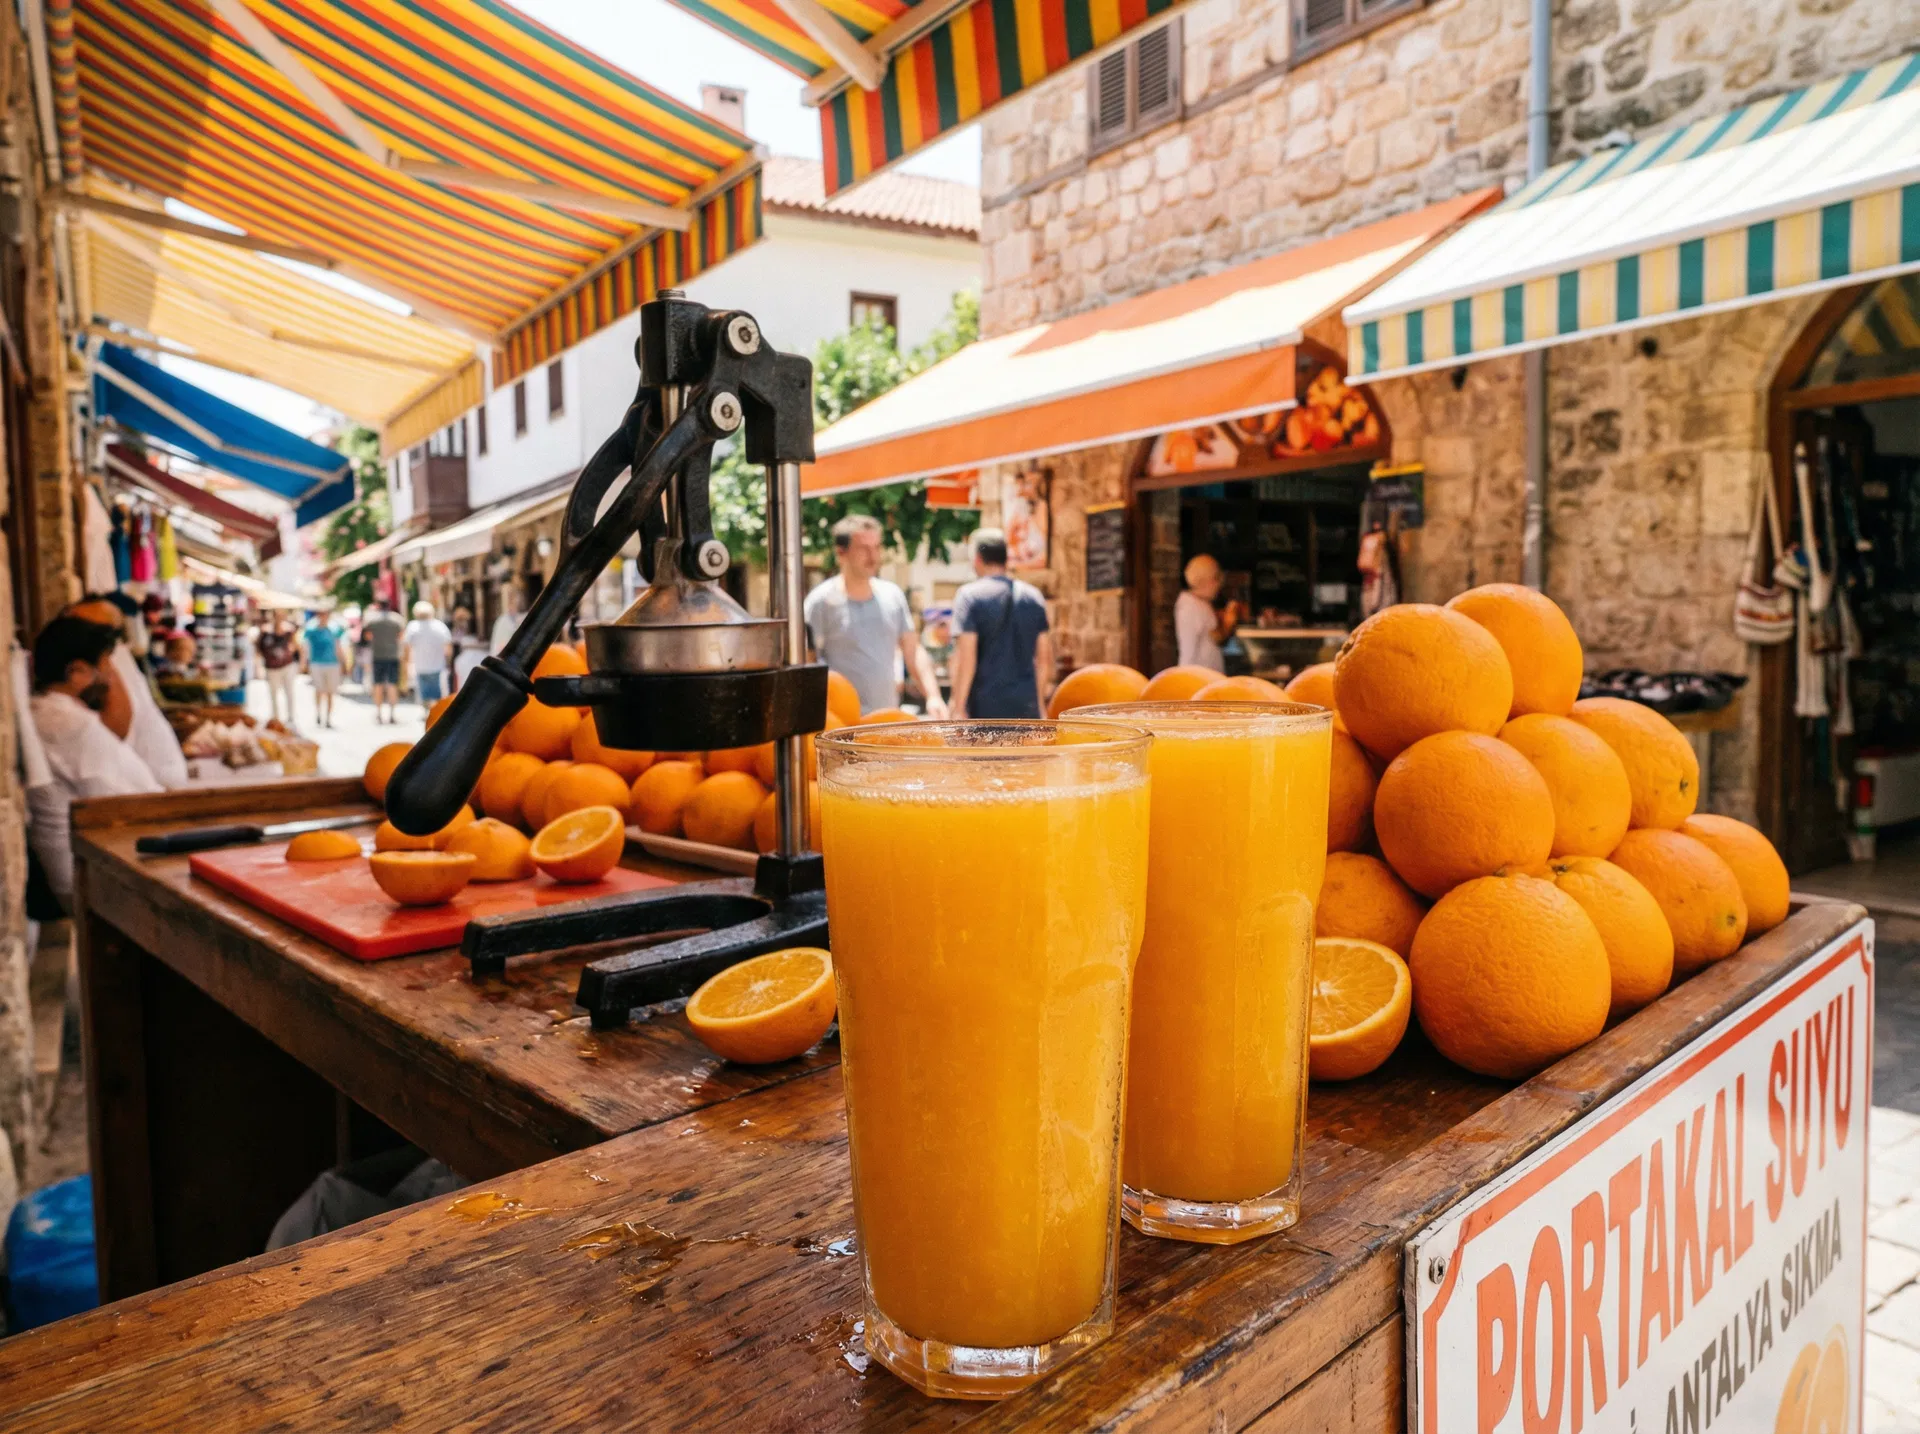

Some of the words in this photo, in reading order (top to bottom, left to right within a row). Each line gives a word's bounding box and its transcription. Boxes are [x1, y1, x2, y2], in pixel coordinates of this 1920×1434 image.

[1477, 1073, 1754, 1434] PORTAKAL
[1766, 985, 1854, 1223] SUYU
[1666, 1279, 1772, 1434] ANTALYA
[1781, 1197, 1841, 1332] SIKMA
